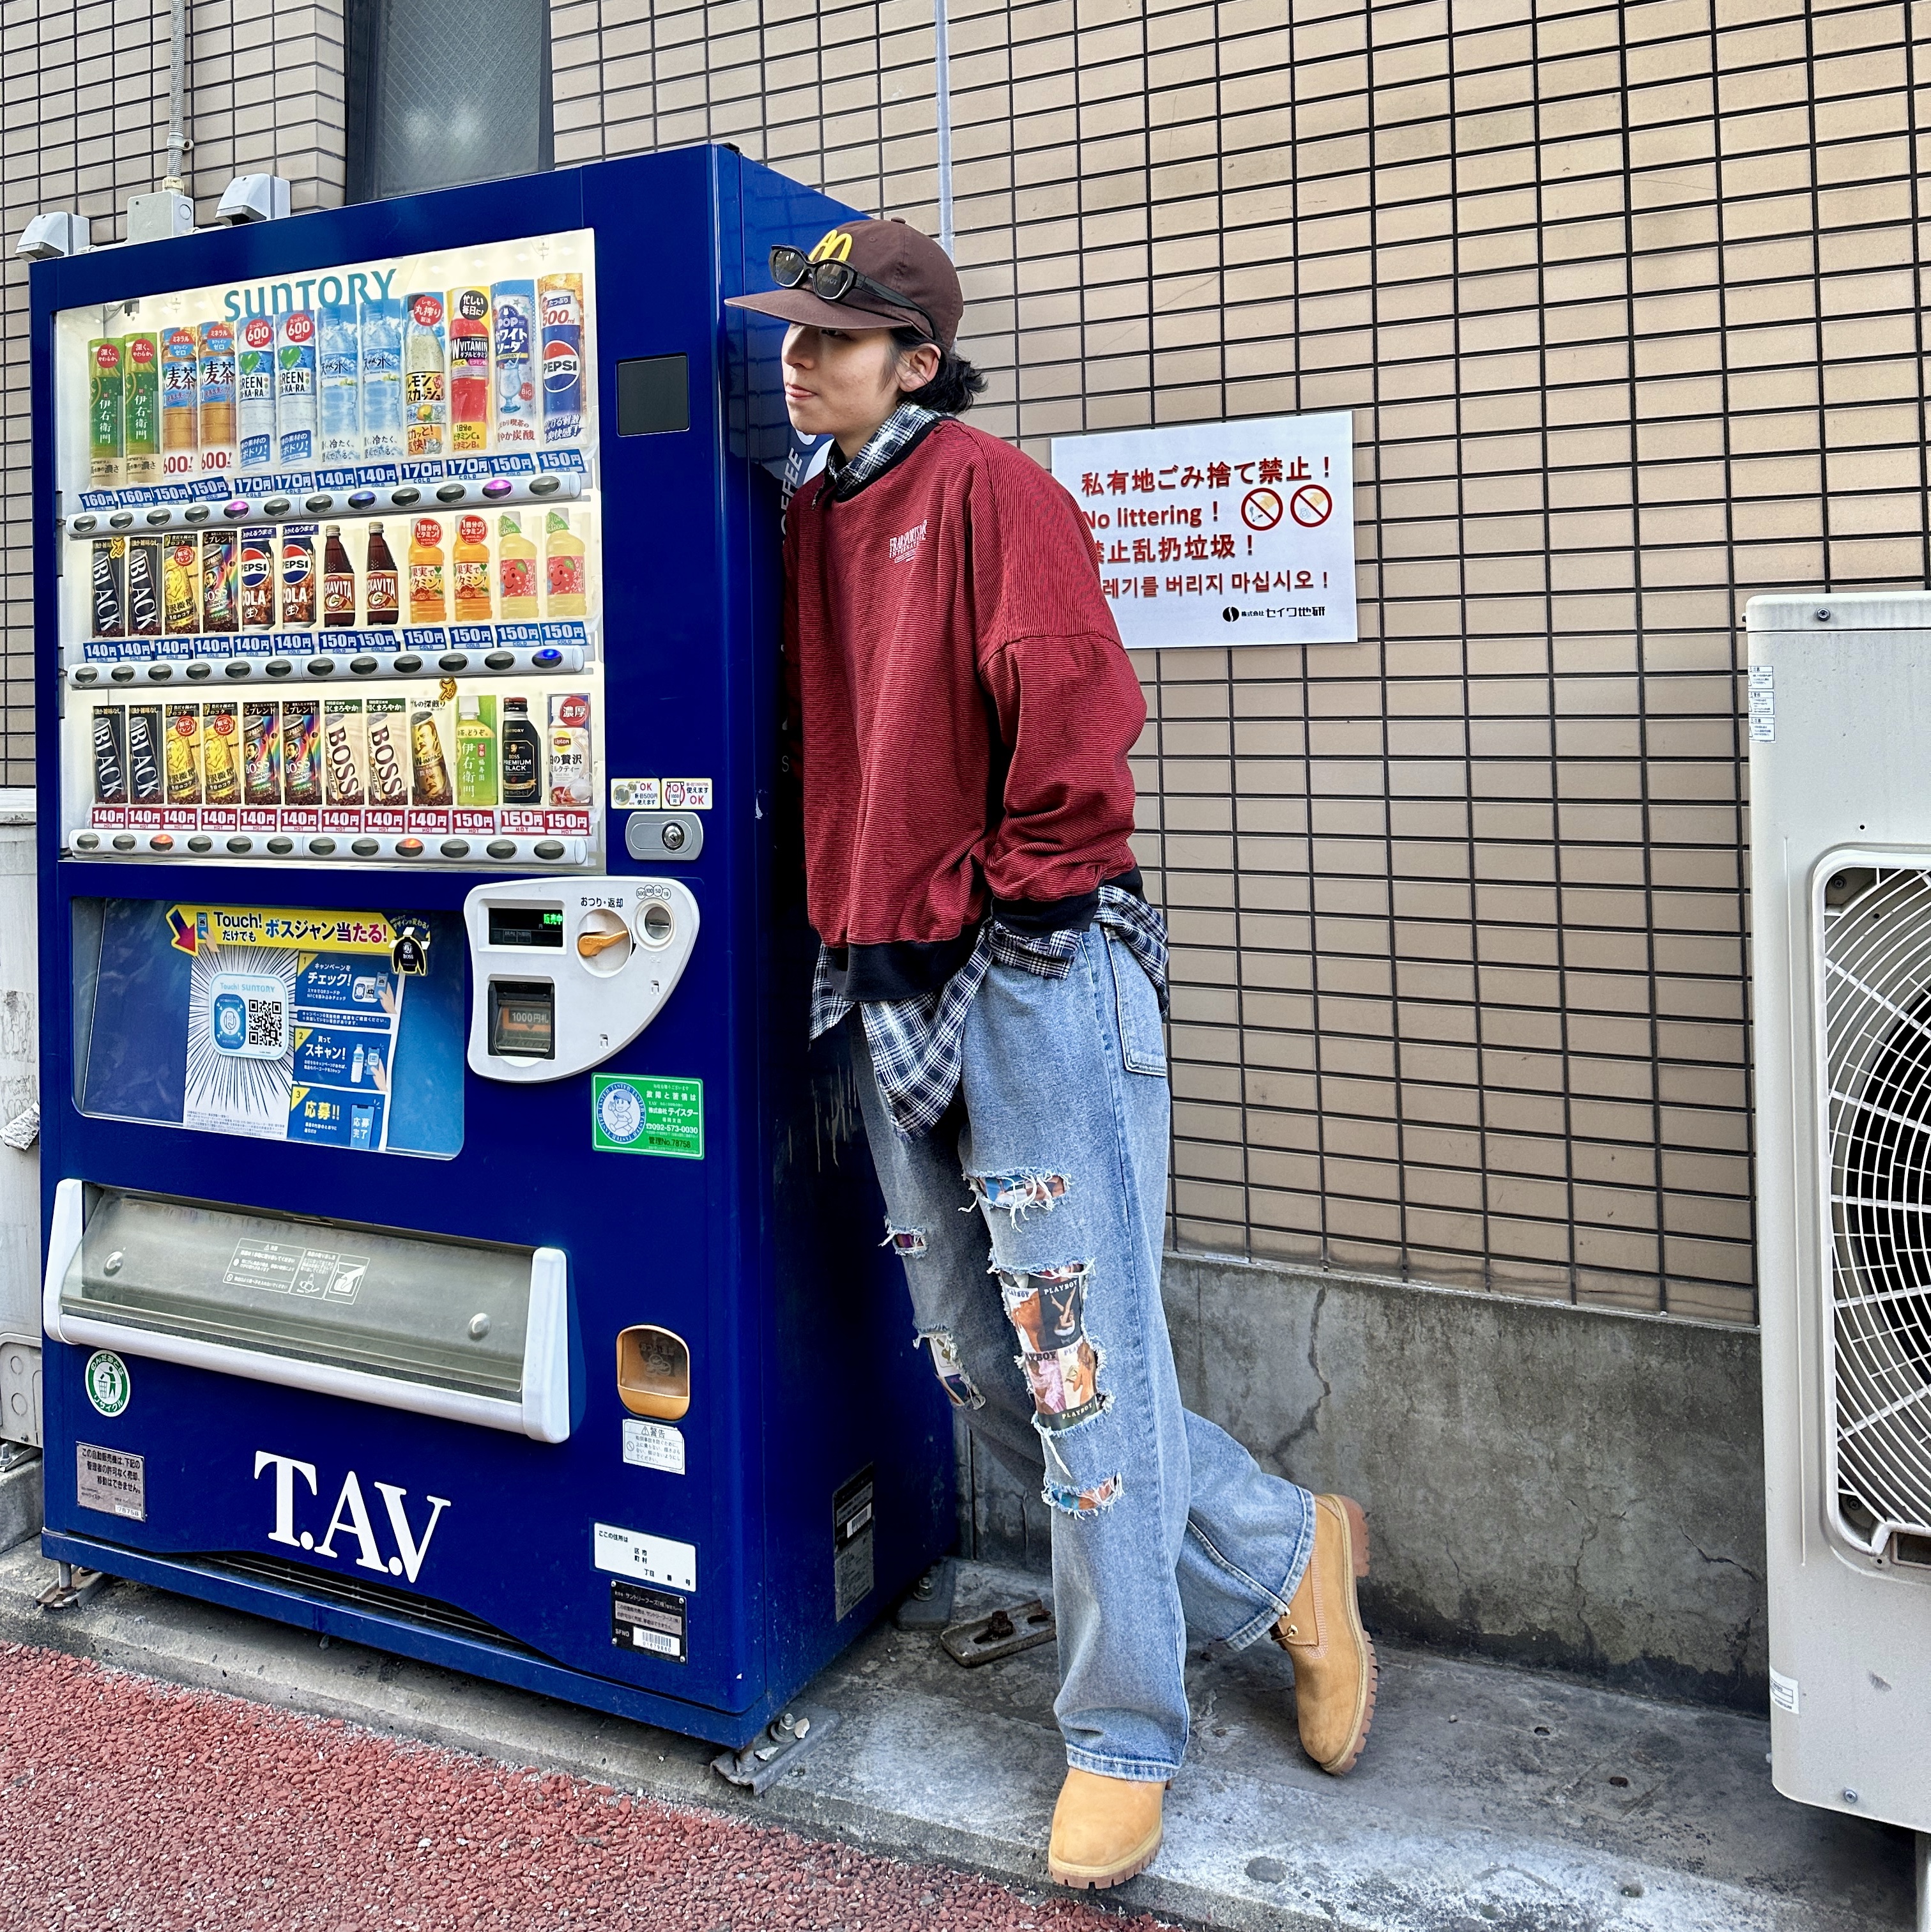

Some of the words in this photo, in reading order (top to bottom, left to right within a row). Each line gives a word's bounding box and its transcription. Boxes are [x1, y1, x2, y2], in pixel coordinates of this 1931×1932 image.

[463, 295, 484, 306] 忙しい
[549, 297, 569, 305] たっぷり
[415, 305, 441, 318] 丸搾り
[462, 305, 484, 316] 毎日に!
[247, 326, 269, 343] 600
[287, 321, 310, 337] 600
[496, 328, 527, 343] ホワイト
[497, 340, 524, 354] ソーダ
[206, 360, 235, 385] 麦茶
[544, 360, 577, 374] PEPSI
[167, 366, 197, 391] 麦茶
[408, 374, 432, 388] レモン
[100, 399, 112, 444] 伊右衛門
[135, 395, 148, 440] 伊右衛門
[448, 459, 488, 474] 170円
[491, 457, 533, 471] 150円
[540, 452, 581, 467] 150円
[358, 468, 396, 482] 140円
[403, 462, 441, 478] 170円
[1081, 456, 1330, 496] 私有地ごみ捨て禁止！
[275, 473, 311, 489] 170円
[316, 471, 354, 486] 140円
[191, 480, 227, 496] 150円
[236, 479, 271, 493] 170円
[82, 494, 115, 507] 160円
[118, 490, 153, 503] 160円
[154, 487, 188, 500] 150円
[781, 447, 803, 543] OFFEE
[416, 523, 438, 532] 1日分の
[461, 519, 484, 528] 1日分の
[1085, 512, 1110, 530] No
[461, 527, 484, 535] ビタミン!
[241, 564, 267, 572] PEPSI
[282, 560, 309, 569] PEPSI
[412, 566, 434, 577] 果実で
[457, 564, 480, 574] 果実で
[1103, 576, 1158, 599] 레기를
[1166, 573, 1223, 595] 버리지
[204, 586, 227, 602] BOSS
[328, 594, 339, 606] C
[371, 592, 383, 604] C
[405, 630, 444, 644] 150円
[452, 629, 491, 642] 150円
[498, 627, 538, 640] 150円
[542, 625, 584, 638] 150円
[195, 640, 229, 652] 140円
[234, 638, 270, 650] 140円
[275, 635, 311, 648] 140円
[320, 634, 357, 647] 150円
[356, 632, 395, 646] 150円
[86, 644, 116, 657] 140円
[118, 643, 150, 656] 140円
[156, 641, 188, 654] 140円
[563, 706, 586, 717] 濃厚
[245, 758, 270, 774] BOSS
[286, 758, 310, 774] BOSS
[328, 726, 358, 795] BOSS
[371, 725, 402, 795] BOSS
[462, 743, 475, 797] 伊右衛門
[640, 783, 652, 791] OK
[690, 795, 705, 805] OK
[93, 810, 124, 823] 140円
[129, 810, 160, 823] 140円
[164, 811, 195, 824] 140円
[202, 811, 236, 824] 140円
[241, 811, 275, 825] 140円
[282, 811, 316, 825] 140円
[323, 812, 359, 825] 140円
[366, 812, 402, 826] 140円
[409, 813, 446, 827] 140円
[454, 813, 492, 827] 150円
[503, 811, 543, 826] 160円
[546, 814, 587, 827] 150円
[581, 897, 623, 908] おつり・返却
[213, 912, 261, 928] Touch!
[222, 931, 256, 942] だけでも
[266, 919, 388, 944] ボスジャン当たる!
[315, 963, 351, 971] キャンペーンを
[308, 972, 351, 986] チェック!
[512, 1012, 549, 1023] 1000円札
[305, 1043, 346, 1060] スキャン!
[304, 1100, 340, 1120] 応募!!
[353, 1117, 370, 1128] 応募
[353, 1129, 368, 1139] 完了
[1007, 1289, 1030, 1298] PLAYBOY
[1044, 1280, 1078, 1295] PLAYBOY
[1025, 1351, 1057, 1361] AYBOY
[91, 1354, 124, 1376] のんだあとは
[94, 1393, 123, 1412] リサイクル
[1062, 1402, 1092, 1419] PLAYBOY
[650, 1427, 665, 1439] 警告
[599, 1530, 629, 1543] ここの住所は
